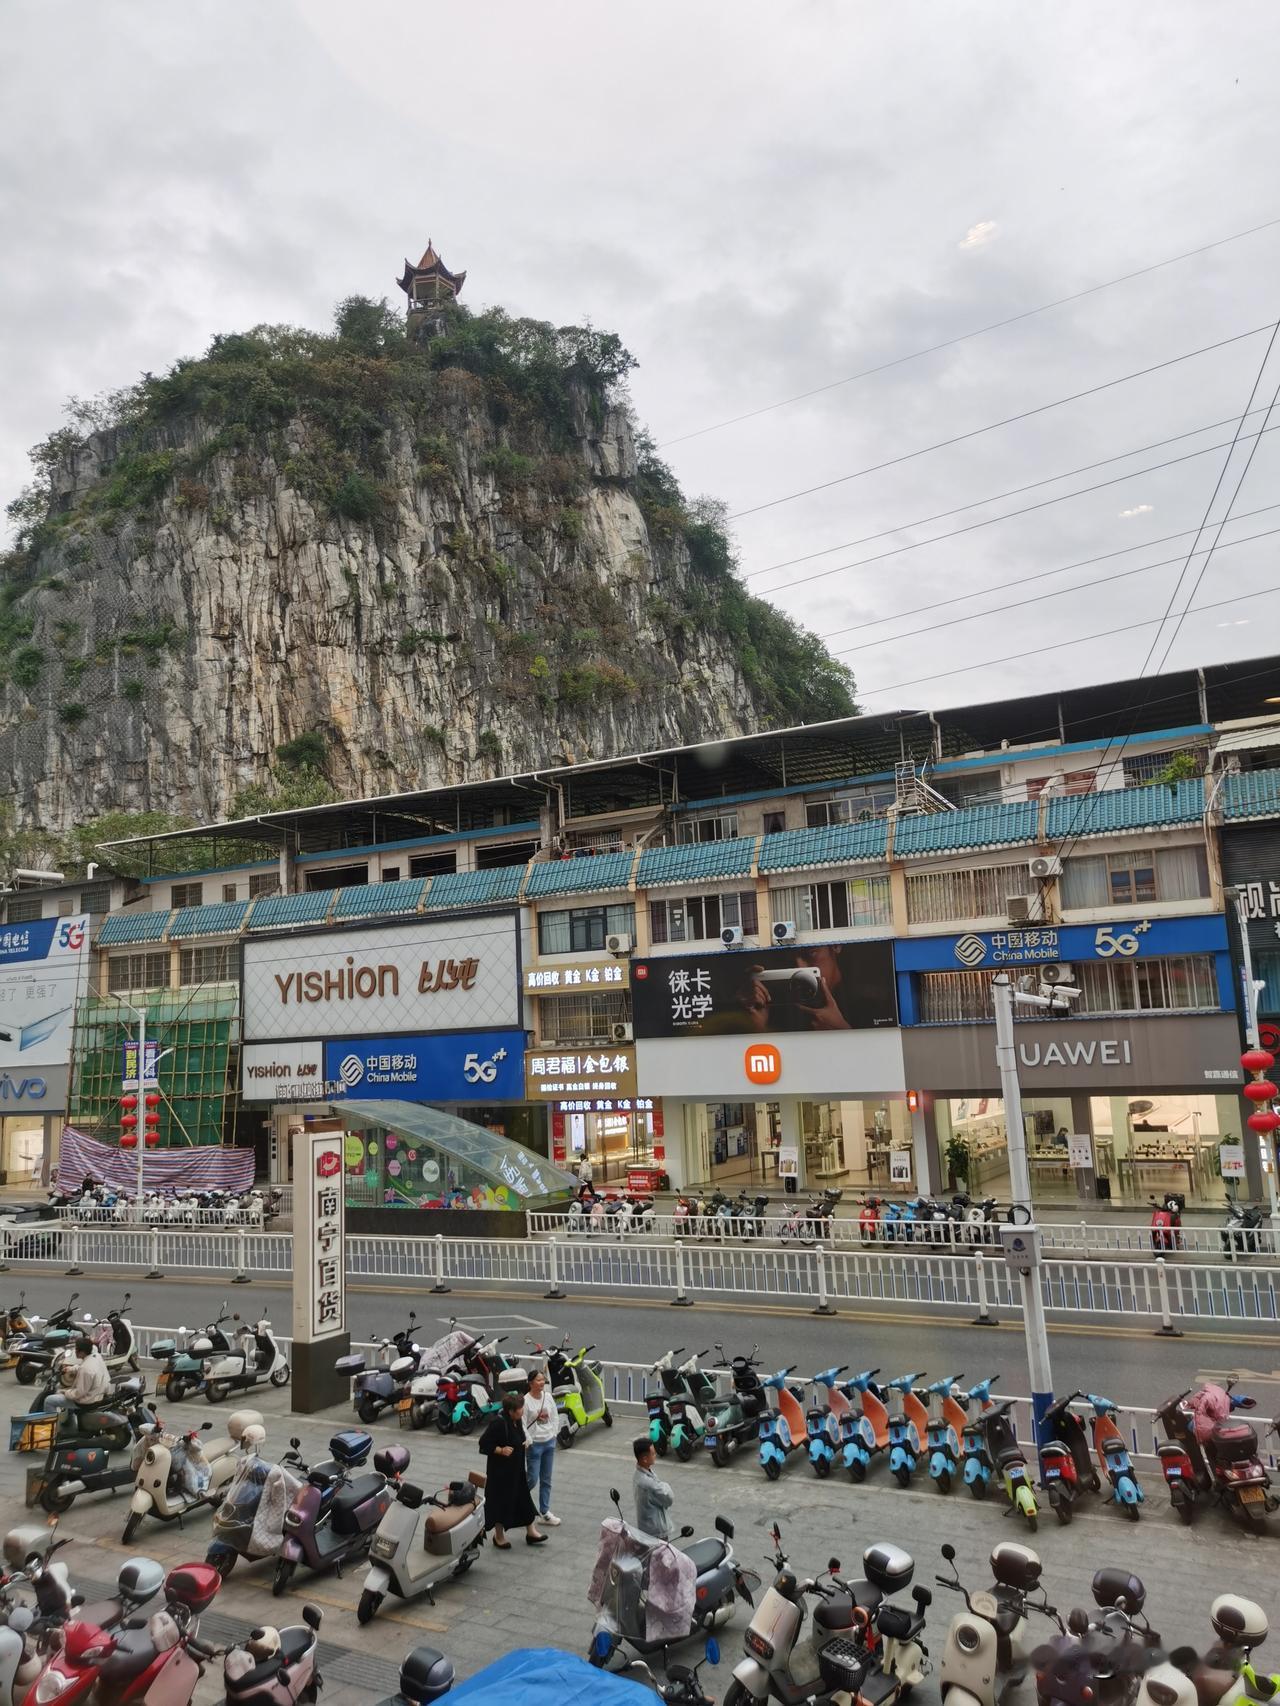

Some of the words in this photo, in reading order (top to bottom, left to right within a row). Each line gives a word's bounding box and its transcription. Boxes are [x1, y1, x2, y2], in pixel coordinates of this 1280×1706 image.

[0, 930, 30, 948] 国电信
[991, 930, 1059, 950] 中国移动
[992, 949, 1022, 962] China
[1024, 947, 1059, 960] Mobile
[417, 957, 480, 994] 以纯
[528, 971, 560, 987] 高价回收
[565, 969, 581, 984] 黄金
[586, 968, 599, 982] K金
[604, 966, 622, 981] 铂金
[668, 968, 711, 993] 徕卡
[671, 994, 713, 1019] 光学
[296, 1064, 318, 1077] 以纯
[366, 1053, 417, 1071] 中国移动
[0, 1072, 47, 1099] ivo
[366, 1073, 389, 1082] China
[391, 1071, 417, 1082] Mobile
[560, 1100, 591, 1111] 高价回收
[596, 1099, 612, 1110] 黄金
[617, 1099, 631, 1109] K金
[636, 1098, 653, 1109] 铂金
[317, 1187, 341, 1324] 南宁百货
